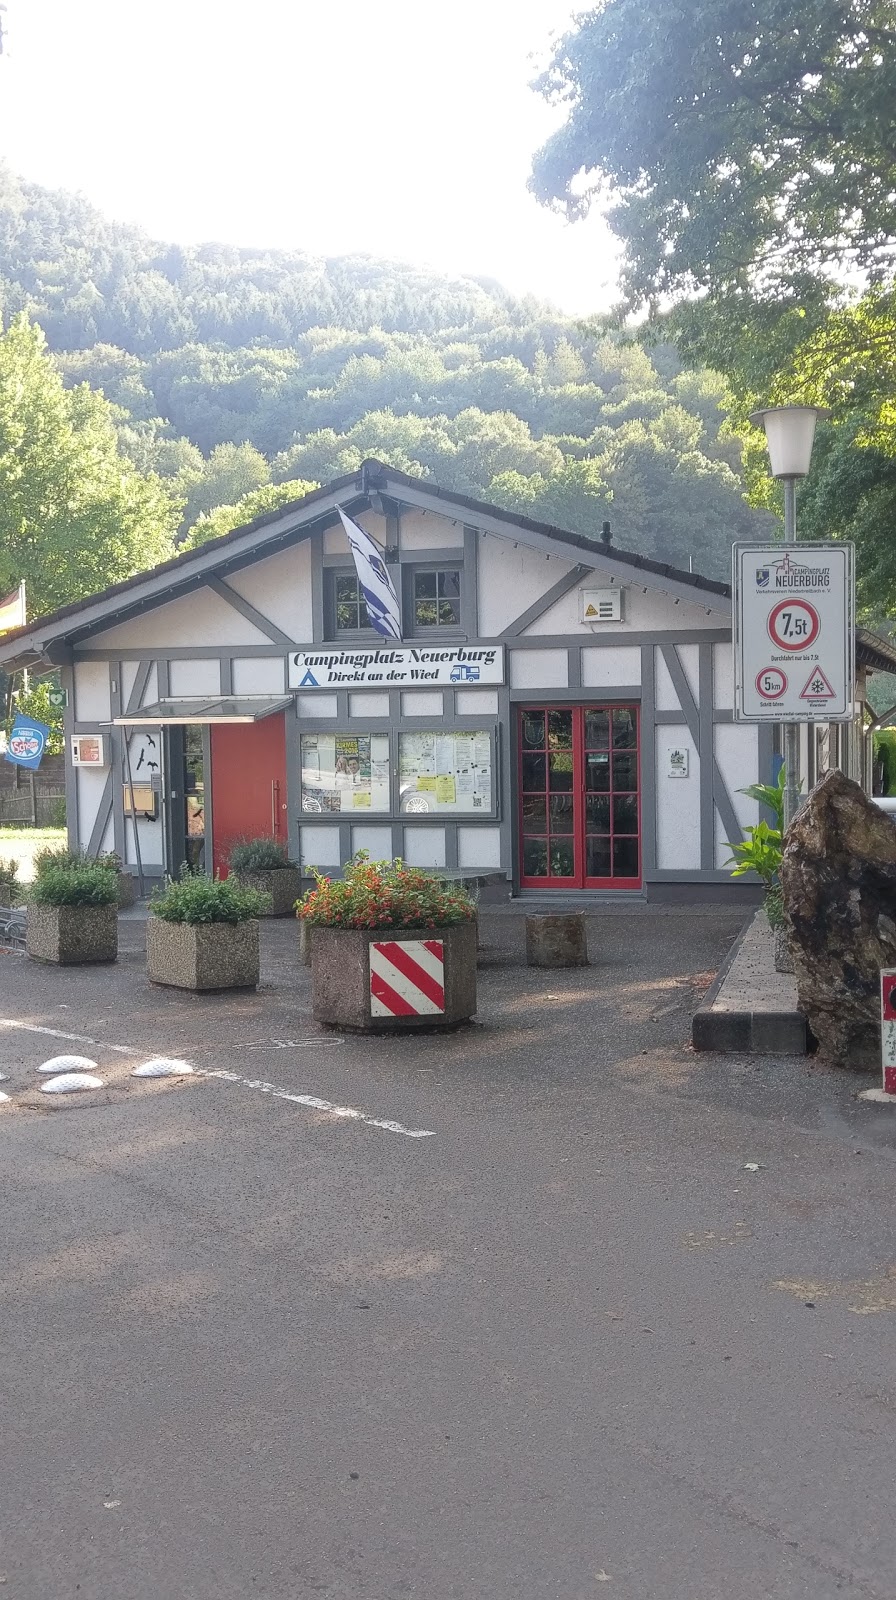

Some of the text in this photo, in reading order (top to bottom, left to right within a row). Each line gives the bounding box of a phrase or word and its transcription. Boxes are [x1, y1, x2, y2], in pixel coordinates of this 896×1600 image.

[775, 575, 830, 587] NEUERBURG
[782, 613, 808, 638] 7,5t
[293, 647, 497, 669] Campingplatz Neuerburg
[327, 668, 440, 682] Direkt an der Wied
